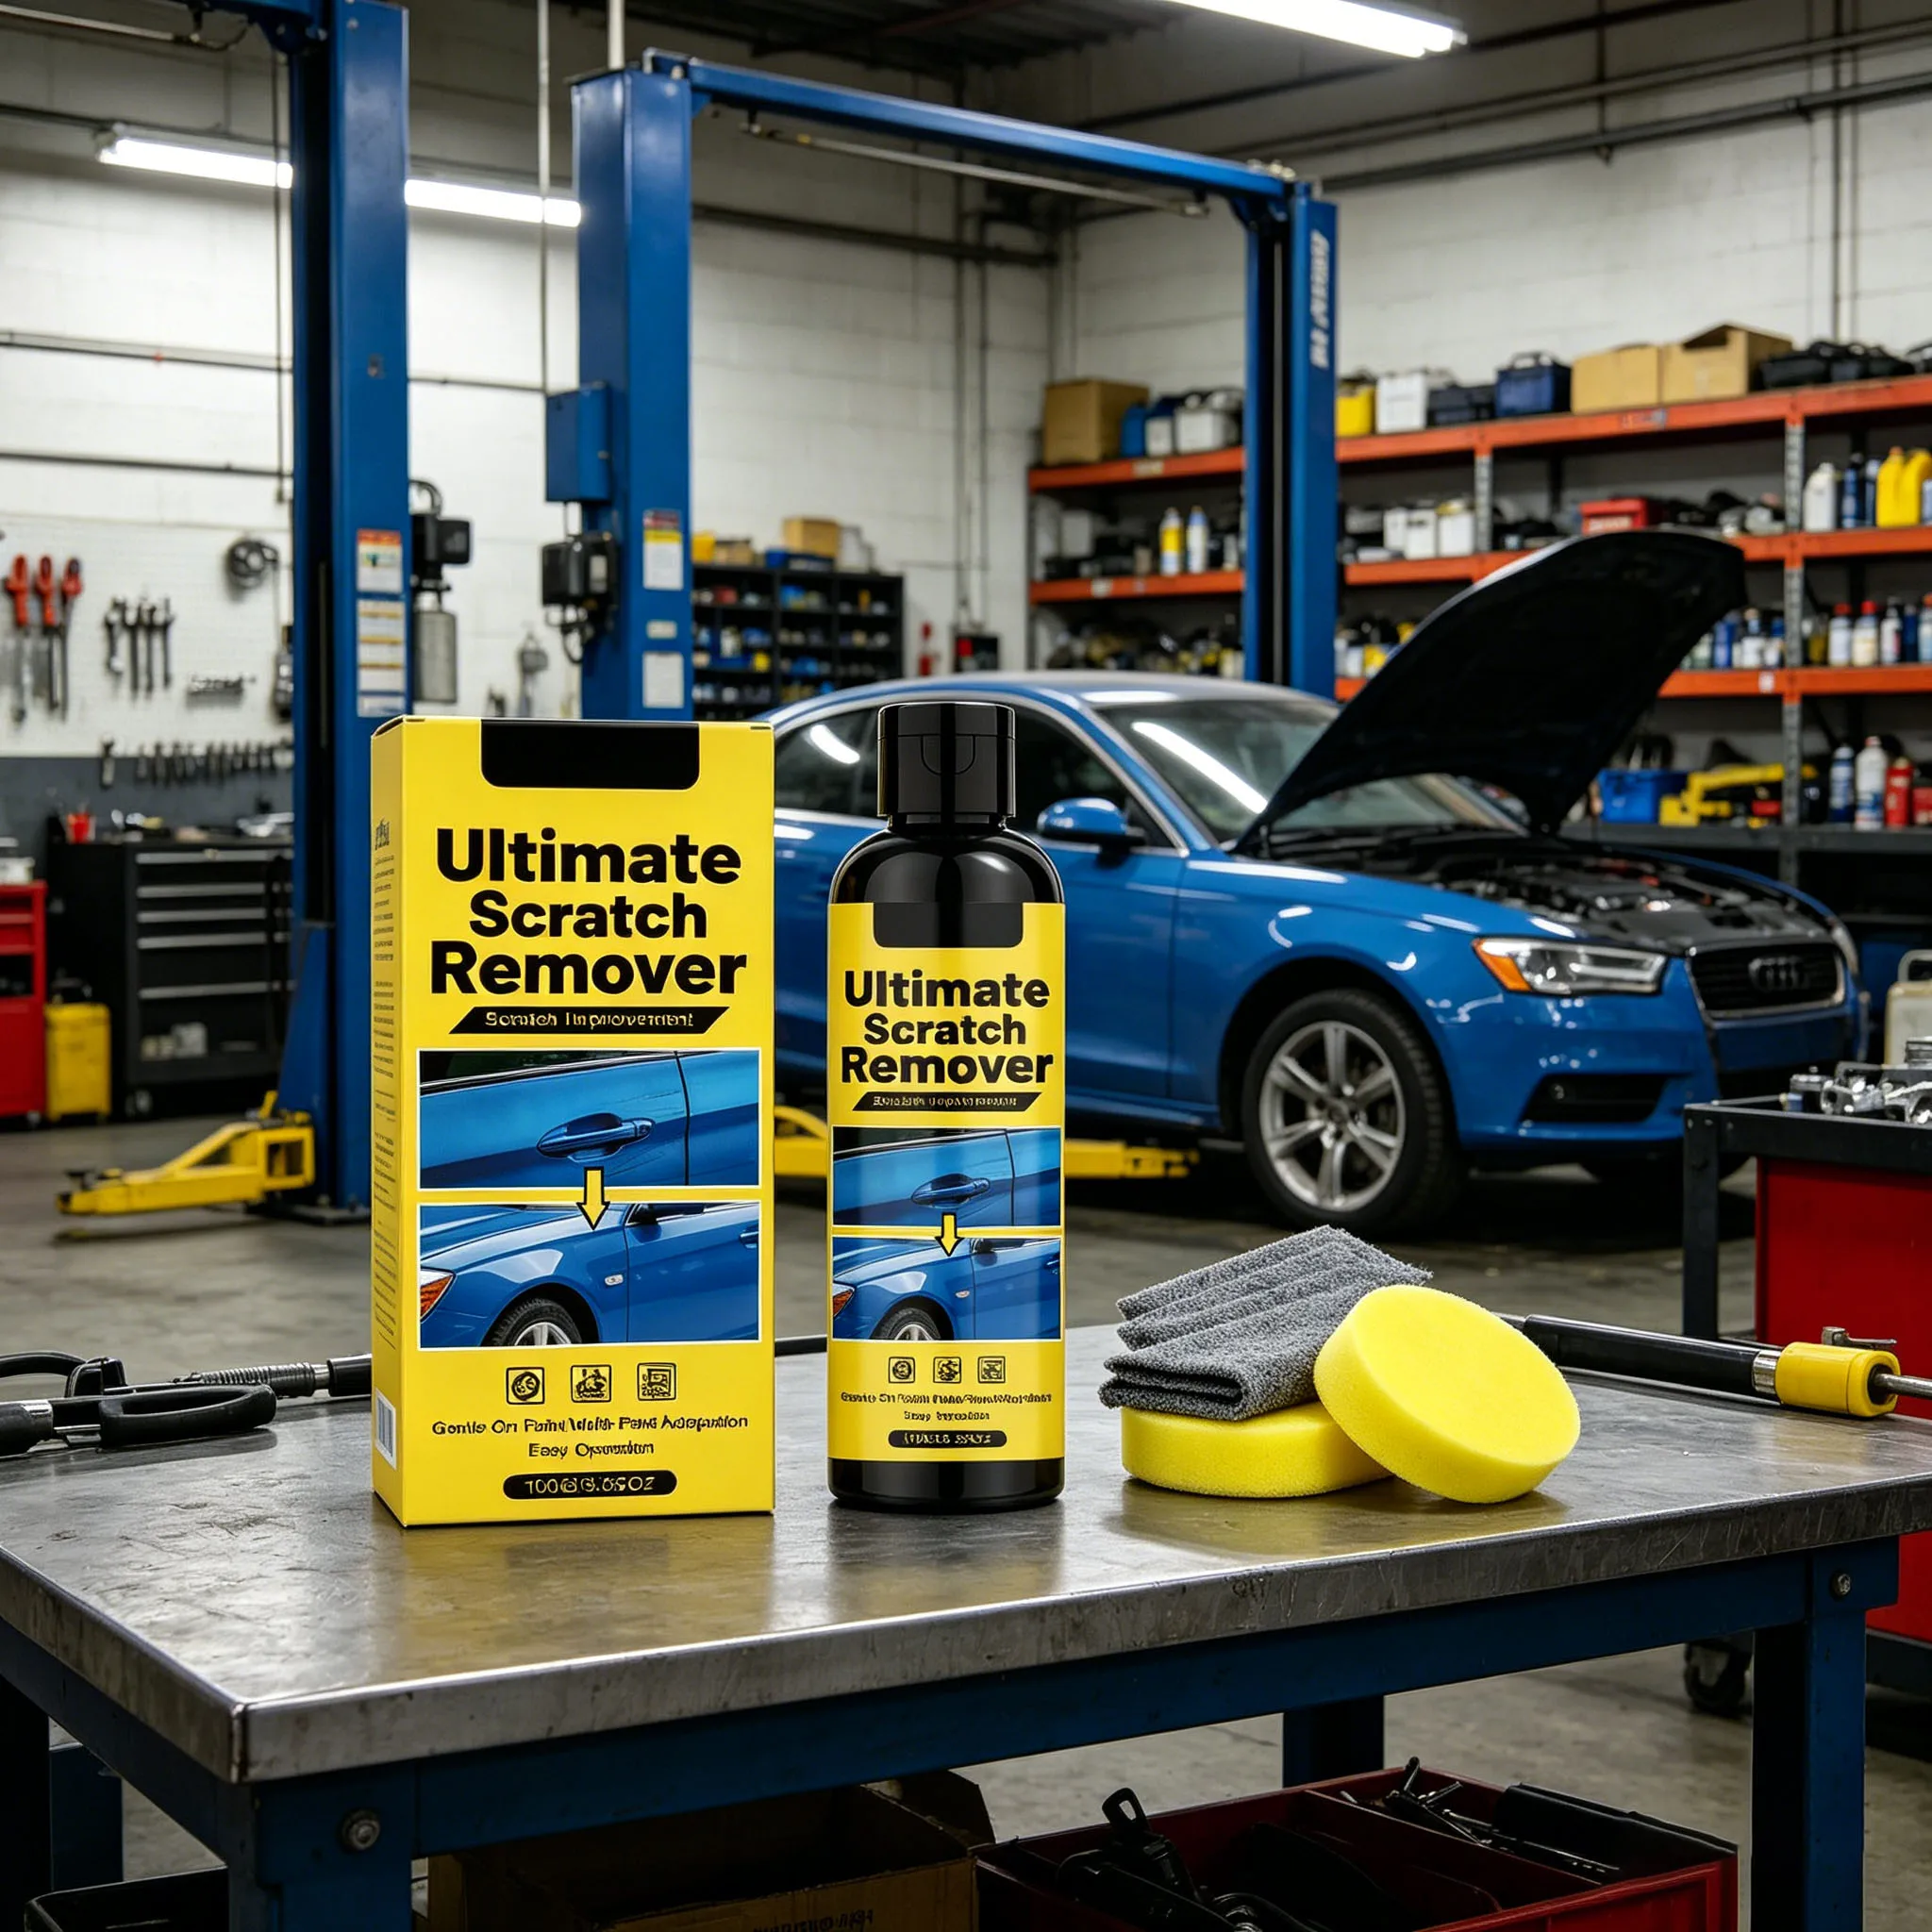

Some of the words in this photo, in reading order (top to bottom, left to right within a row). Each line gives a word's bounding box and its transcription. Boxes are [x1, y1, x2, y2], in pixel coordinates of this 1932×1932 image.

[437, 826, 741, 885] Ultimate
[469, 889, 708, 939] Scratch
[431, 940, 747, 995] Remover
[844, 969, 1050, 1008] Ultimate
[863, 1012, 1026, 1045] Scratch
[841, 1046, 1054, 1085] Remover
